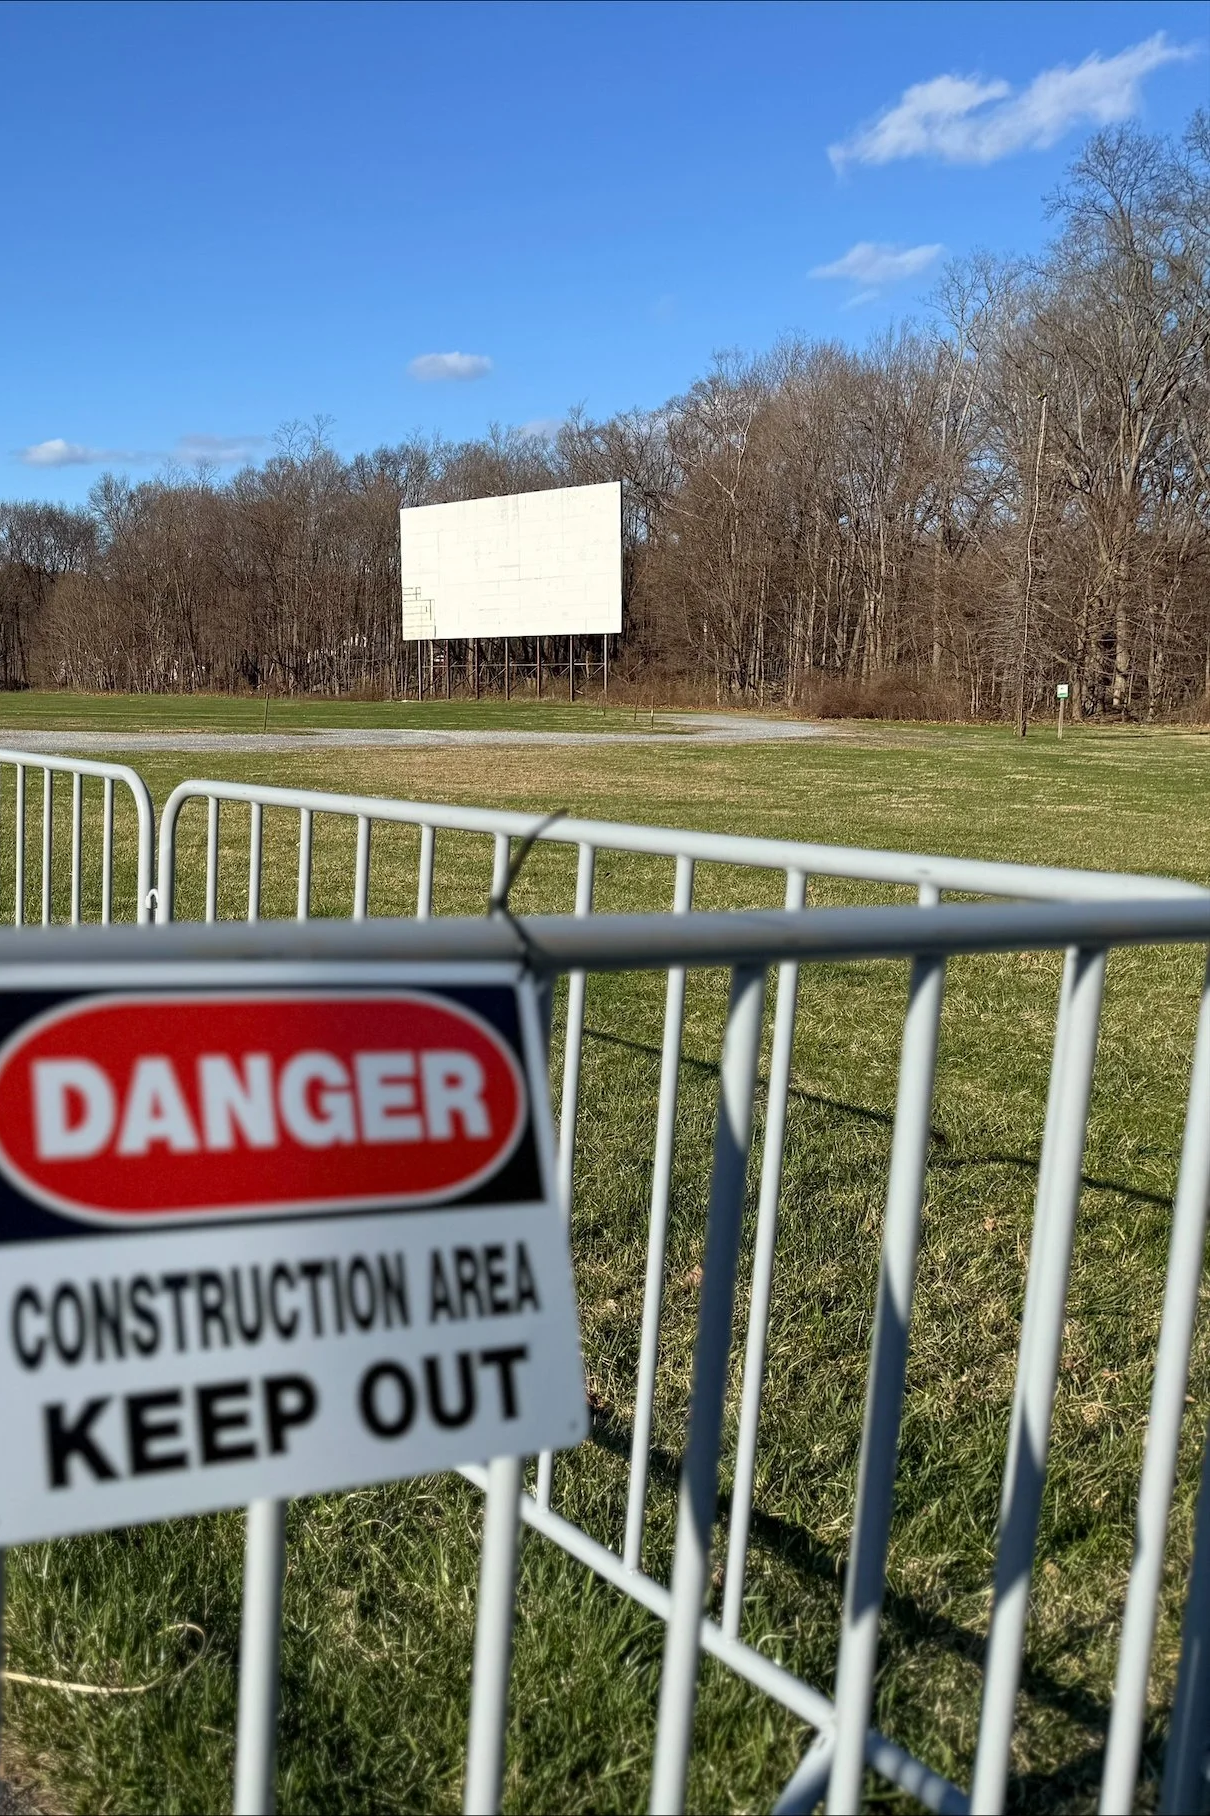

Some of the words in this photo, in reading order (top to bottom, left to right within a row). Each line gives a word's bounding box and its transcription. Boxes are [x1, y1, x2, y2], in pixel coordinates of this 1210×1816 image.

[33, 1050, 490, 1161] DANGER
[11, 1251, 411, 1371] CONSTRUCTION
[430, 1241, 541, 1325] AREA
[44, 1373, 319, 1491] KEEP
[358, 1345, 529, 1440] OUT
